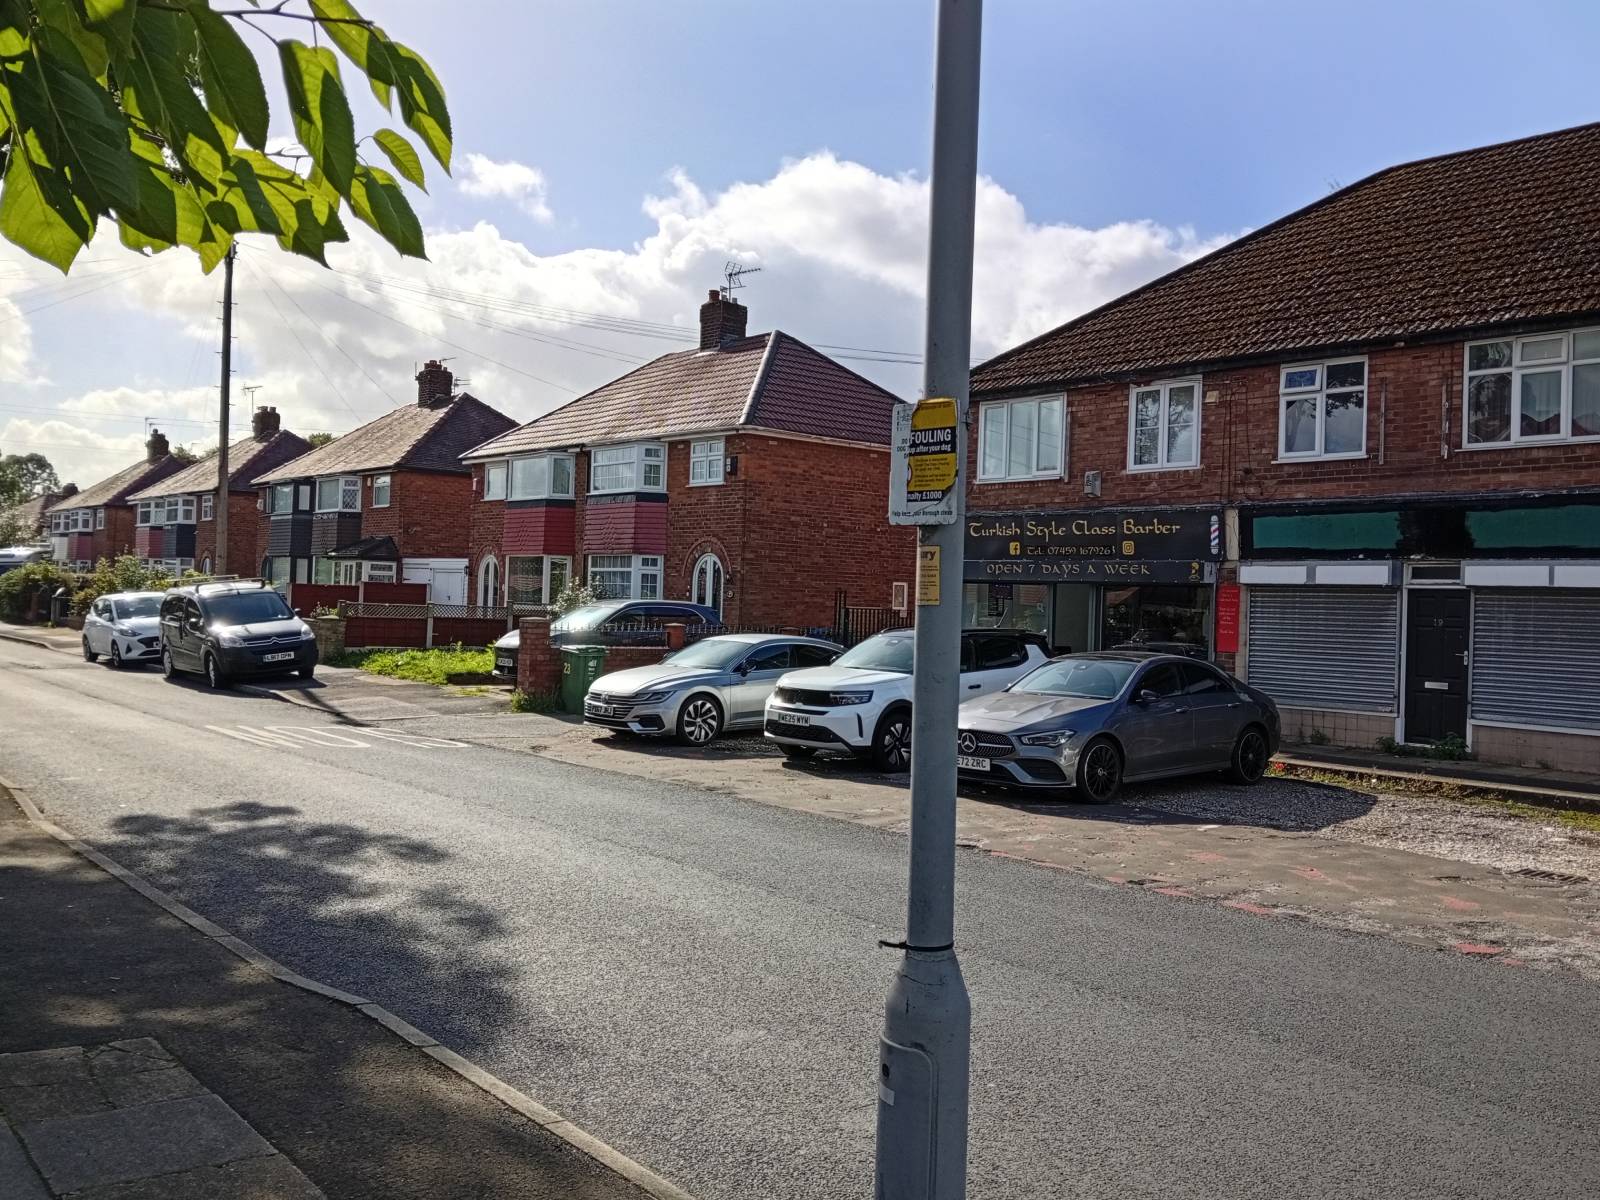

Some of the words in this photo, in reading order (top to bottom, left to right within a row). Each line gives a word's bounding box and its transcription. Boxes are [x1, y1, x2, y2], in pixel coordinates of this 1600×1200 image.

[911, 428, 952, 445] FOULING
[941, 443, 951, 452] dog
[922, 491, 942, 500] £1000
[968, 522, 1021, 537] Turkish
[1026, 520, 1066, 543] Style
[1072, 520, 1116, 535] Class
[1123, 518, 1181, 534] Barber
[986, 564, 1023, 575] OPEN
[1028, 564, 1036, 574] 7
[1042, 564, 1080, 578] DAYS
[1087, 564, 1096, 574] A
[1104, 564, 1151, 575] WEEK
[563, 662, 571, 675] 23
[971, 758, 987, 769] ZRC
